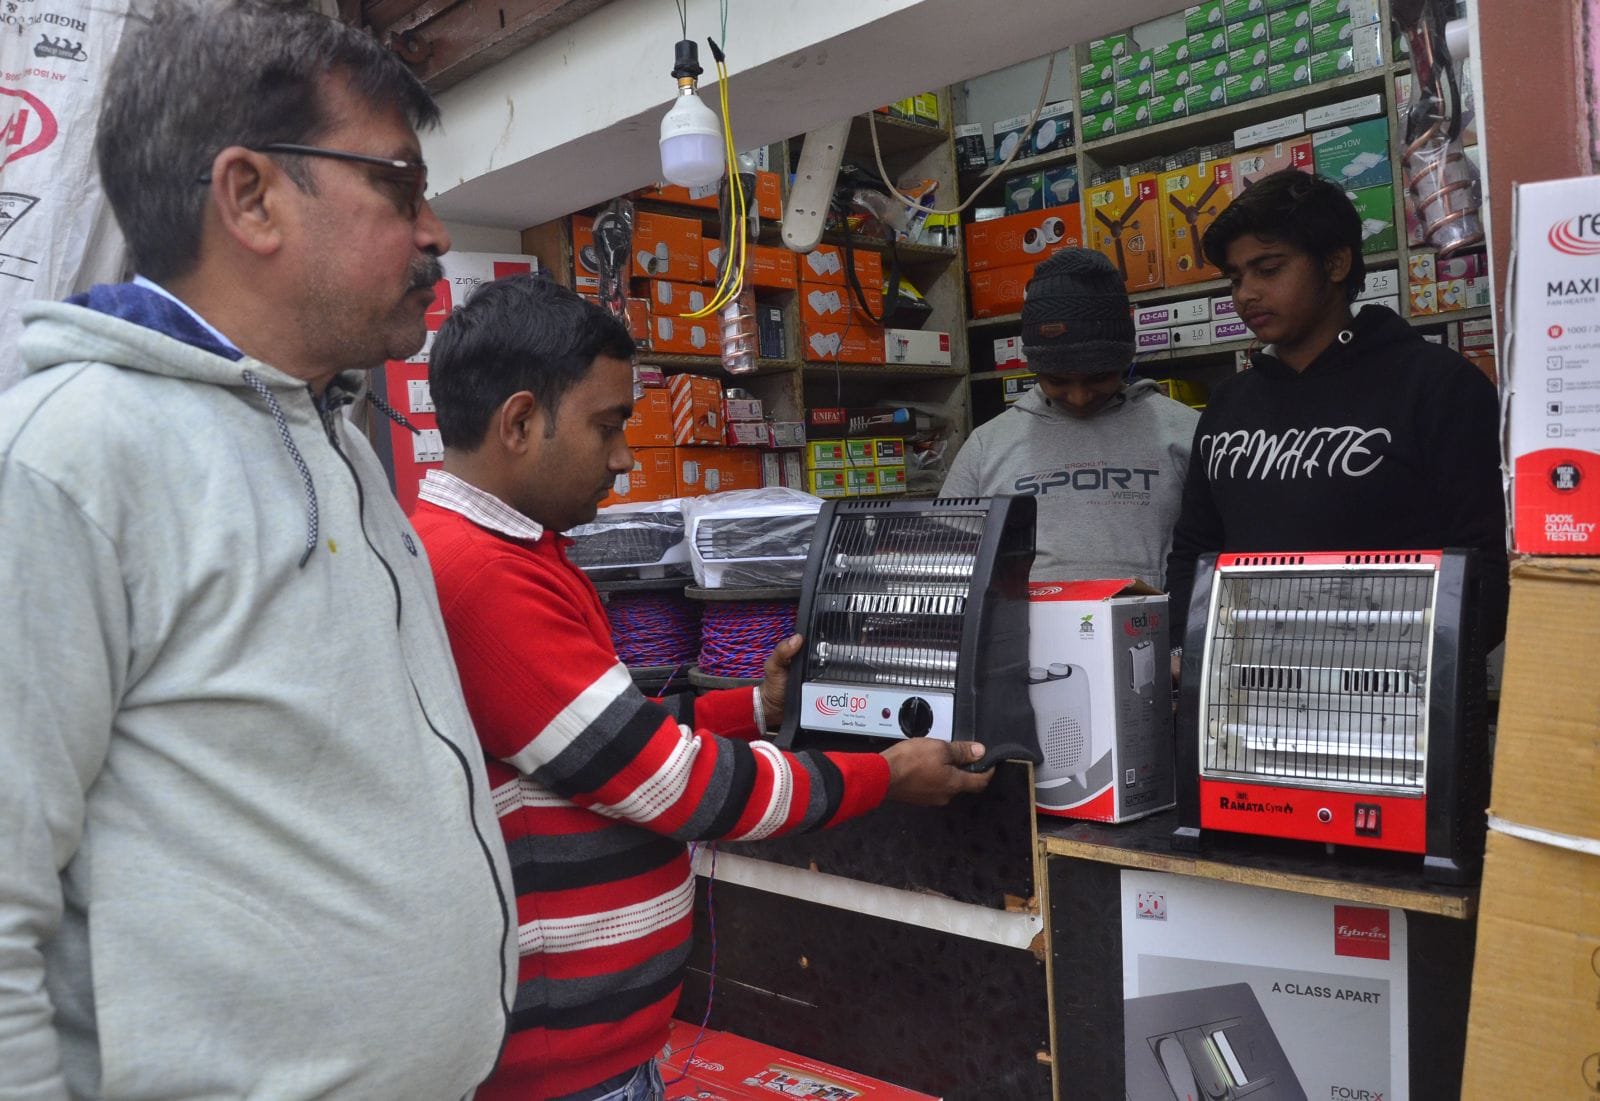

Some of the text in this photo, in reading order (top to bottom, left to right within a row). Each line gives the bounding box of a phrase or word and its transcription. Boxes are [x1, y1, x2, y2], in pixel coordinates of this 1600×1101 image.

[44, 13, 86, 32] RIGID
[1372, 275, 1388, 288] 2.5
[1547, 277, 1600, 297] MAXI
[1140, 311, 1168, 322] A2-CAB
[1192, 304, 1203, 314] 1.5
[1140, 329, 1204, 343] A2-CAB 1.0
[1217, 324, 1246, 334] A2-CAB
[1567, 326, 1587, 334] 1000
[1015, 468, 1160, 496] SPORT
[1111, 491, 1151, 500] WEAR
[1545, 513, 1573, 523] 100%
[1545, 523, 1595, 533] QUALITY
[1545, 532, 1588, 542] TESTED
[826, 693, 867, 713] redi go
[1219, 797, 1265, 813] RAMATA
[1271, 982, 1381, 1004] A CLASS APART
[1331, 1085, 1384, 1101] FOUR-X
